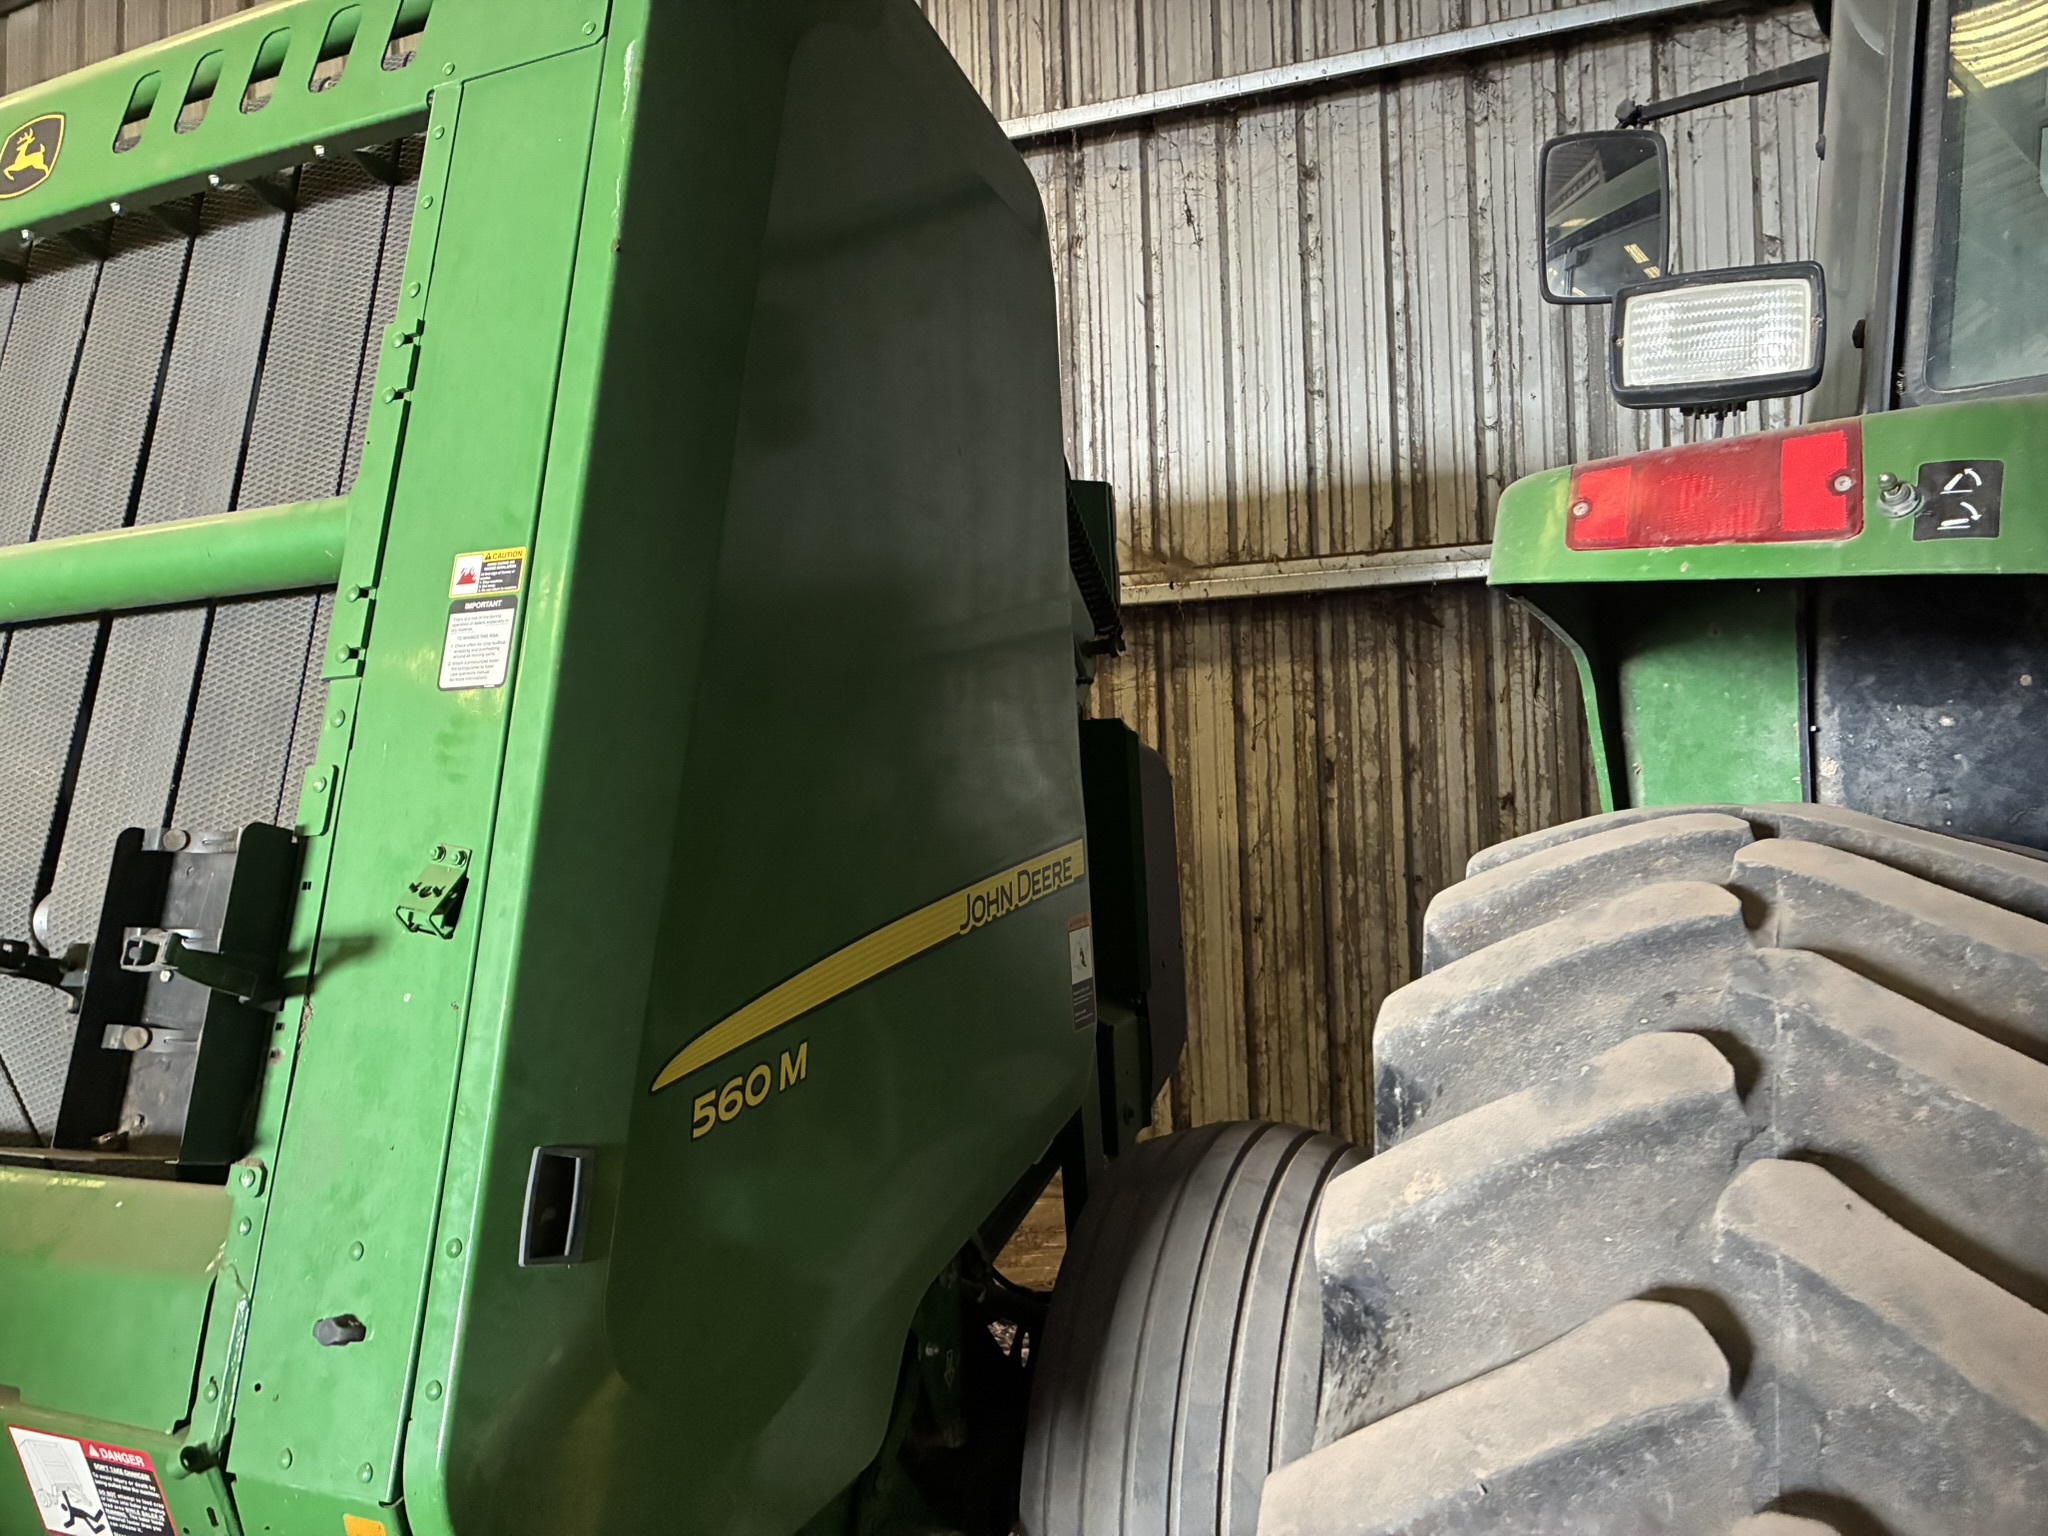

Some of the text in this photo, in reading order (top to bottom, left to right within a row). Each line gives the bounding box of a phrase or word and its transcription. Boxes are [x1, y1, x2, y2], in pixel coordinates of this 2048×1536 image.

[492, 550, 523, 560] CAUTION
[464, 600, 503, 610] IMPORTANT
[960, 856, 1073, 931] JOHN DEERE
[693, 1041, 808, 1139] 560 M
[99, 1448, 145, 1468] DANGER
